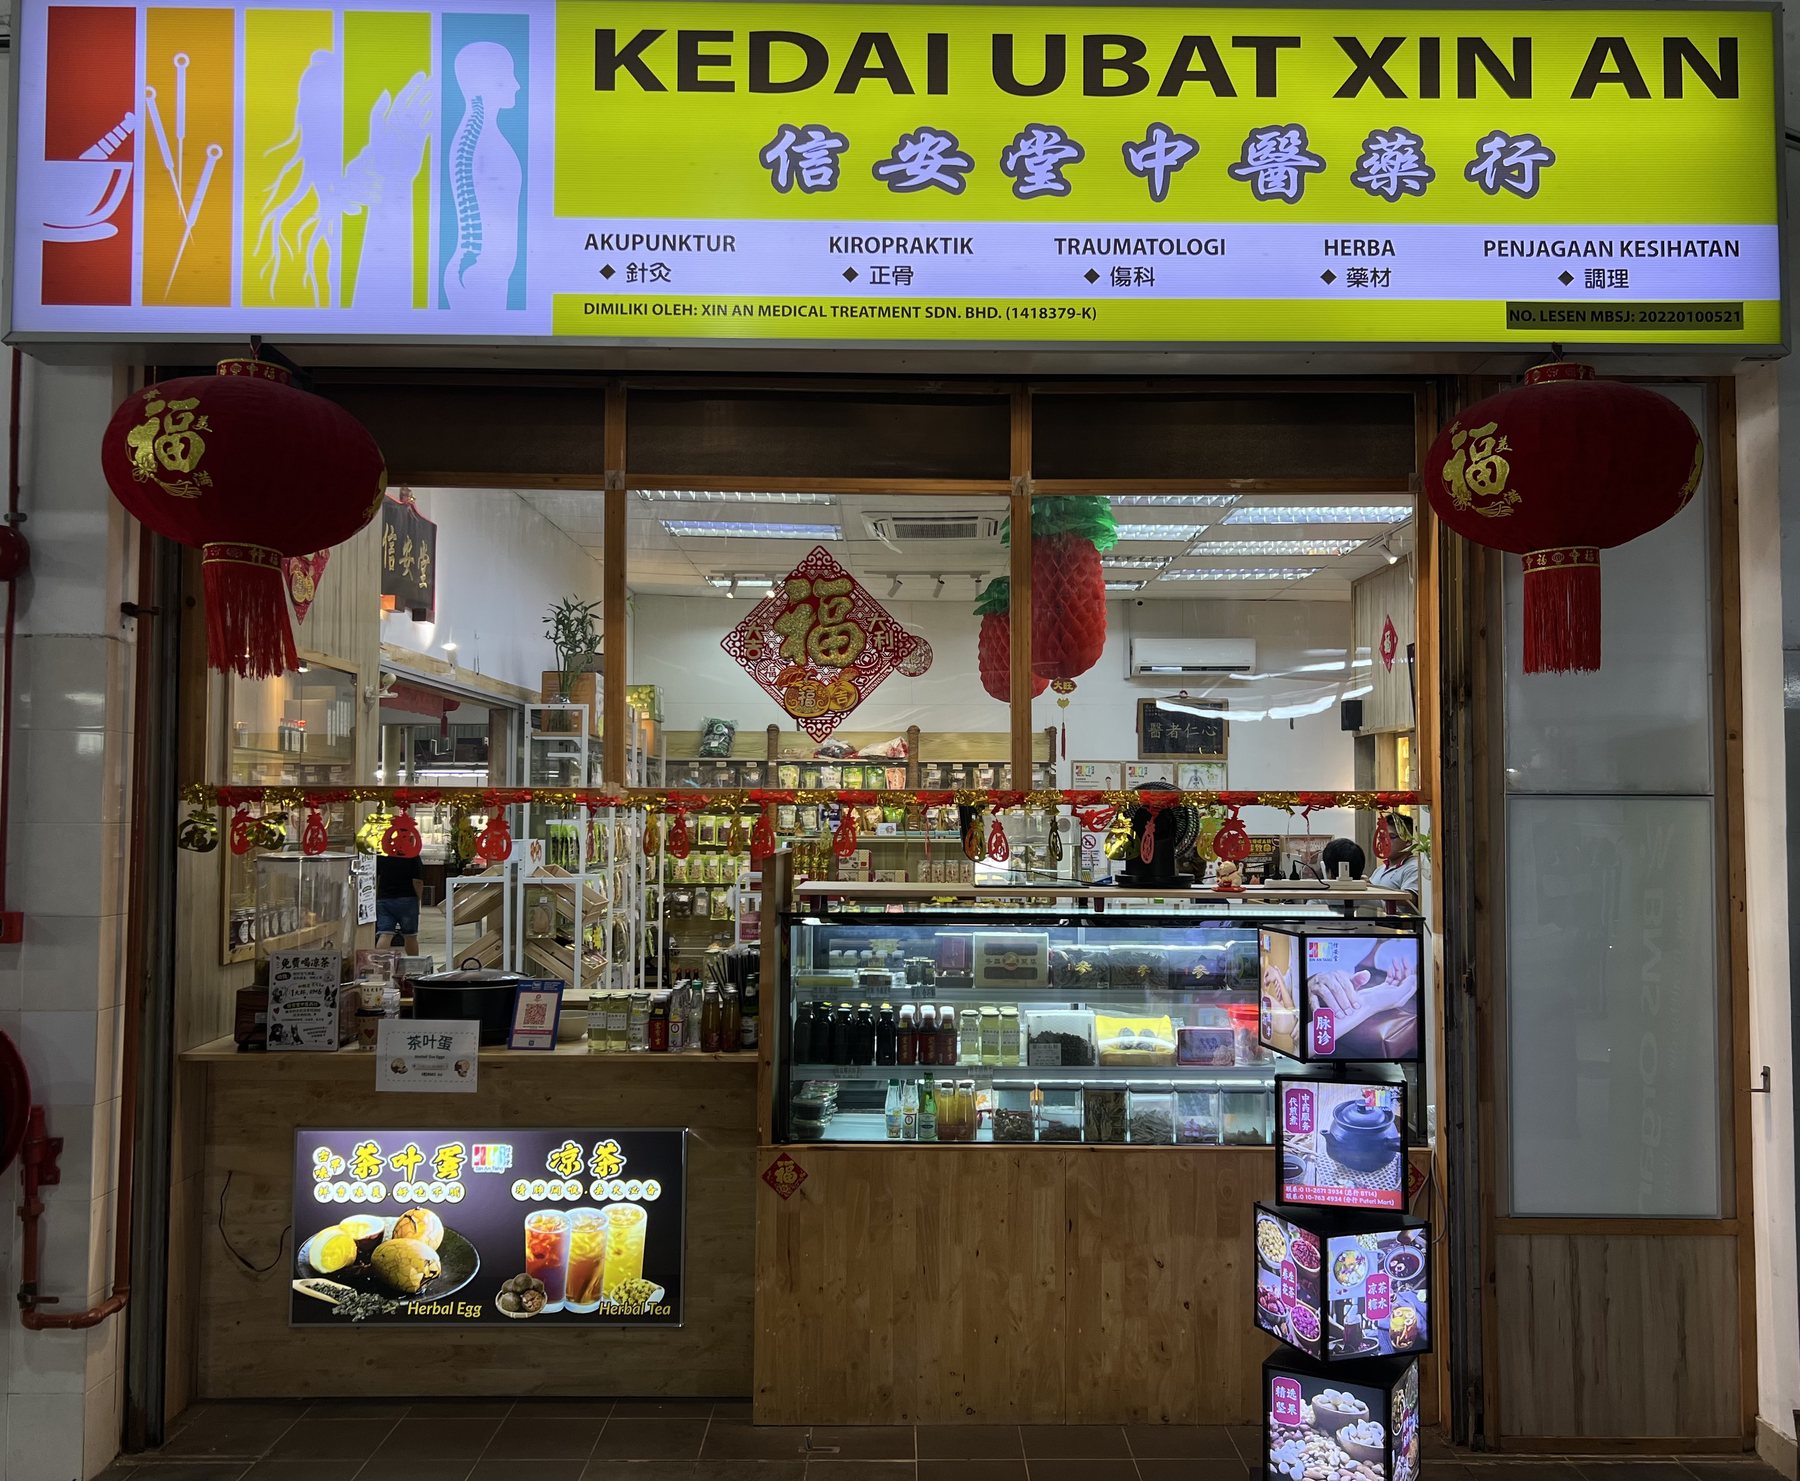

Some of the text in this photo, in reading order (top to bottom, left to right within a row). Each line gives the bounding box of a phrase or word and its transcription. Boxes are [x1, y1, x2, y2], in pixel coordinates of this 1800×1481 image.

[594, 28, 1741, 100] KEDAI UBAT XIN AN
[759, 122, 1556, 204] 信安堂中醫藥行
[584, 233, 736, 252] AKUPUNKTUR
[829, 236, 974, 255] KIROPRAKTIK
[1053, 237, 1225, 256] TRAUMATOLOGI
[1324, 239, 1396, 257] HERBA
[1483, 239, 1740, 258] PENJAGAAN KESIHATAN
[625, 262, 672, 284] 針灸
[869, 265, 914, 287] 正骨
[1109, 265, 1156, 288] 傷科
[1345, 266, 1392, 288] 藥材
[1584, 268, 1630, 290] 調理
[584, 303, 1097, 320] DIMILIKI OLEH: XIN AN MEDICAL TREATMENT SDN. BHD. (1418379-K)
[1509, 309, 1741, 323] NO. LESEN MBSJ: 20220100521
[127, 396, 206, 474] 福
[1442, 421, 1511, 497] 福
[381, 523, 431, 589] 信安堂
[774, 577, 867, 669] 福
[1148, 722, 1219, 739] 醫者仁心
[1315, 1014, 1332, 1047] 脉诊
[406, 1033, 454, 1052] 茶叶蛋
[349, 1141, 466, 1184] 茶叶蛋
[548, 1140, 625, 1180] 凉茶
[407, 1300, 482, 1318] Herbal Egg
[598, 1301, 672, 1316] Herbal Tea
